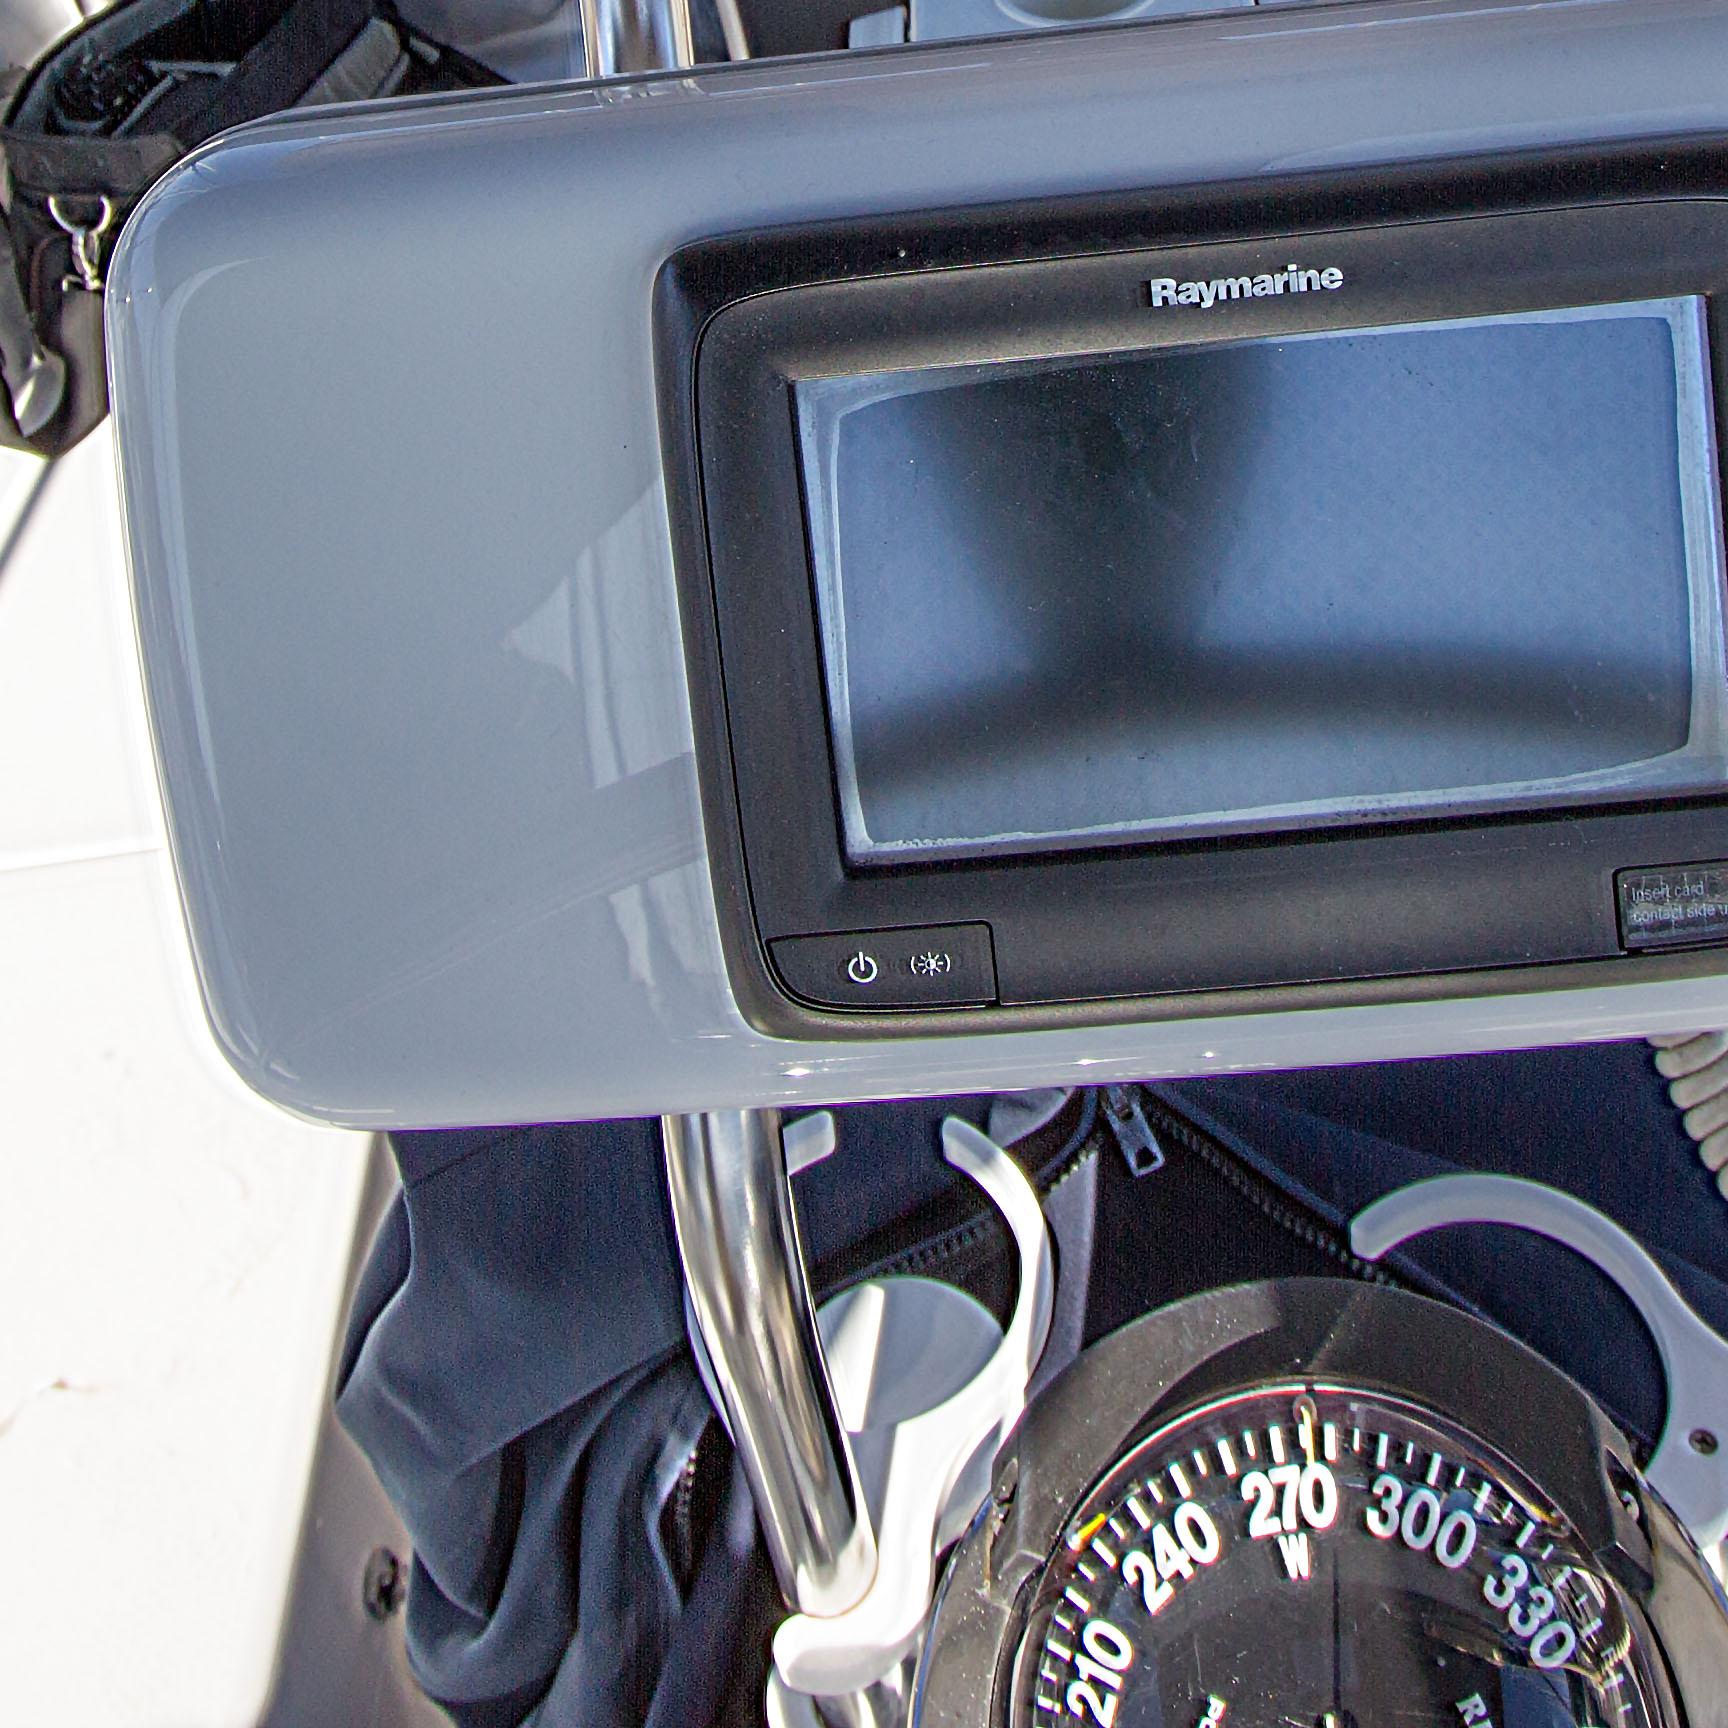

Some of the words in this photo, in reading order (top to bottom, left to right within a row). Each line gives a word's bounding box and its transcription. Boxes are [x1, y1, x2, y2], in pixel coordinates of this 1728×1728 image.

[1149, 263, 1345, 309] Raymarine
[1631, 883, 1672, 902] Insert
[1674, 880, 1705, 897] card
[1633, 904, 1683, 923] contact
[1686, 902, 1716, 919] side
[1240, 1464, 1338, 1540] 270
[1366, 1473, 1477, 1569] 300
[1122, 1500, 1221, 1614] 240
[1276, 1531, 1310, 1581] W
[1483, 1554, 1576, 1669] 330
[1066, 1617, 1134, 1728] 210
